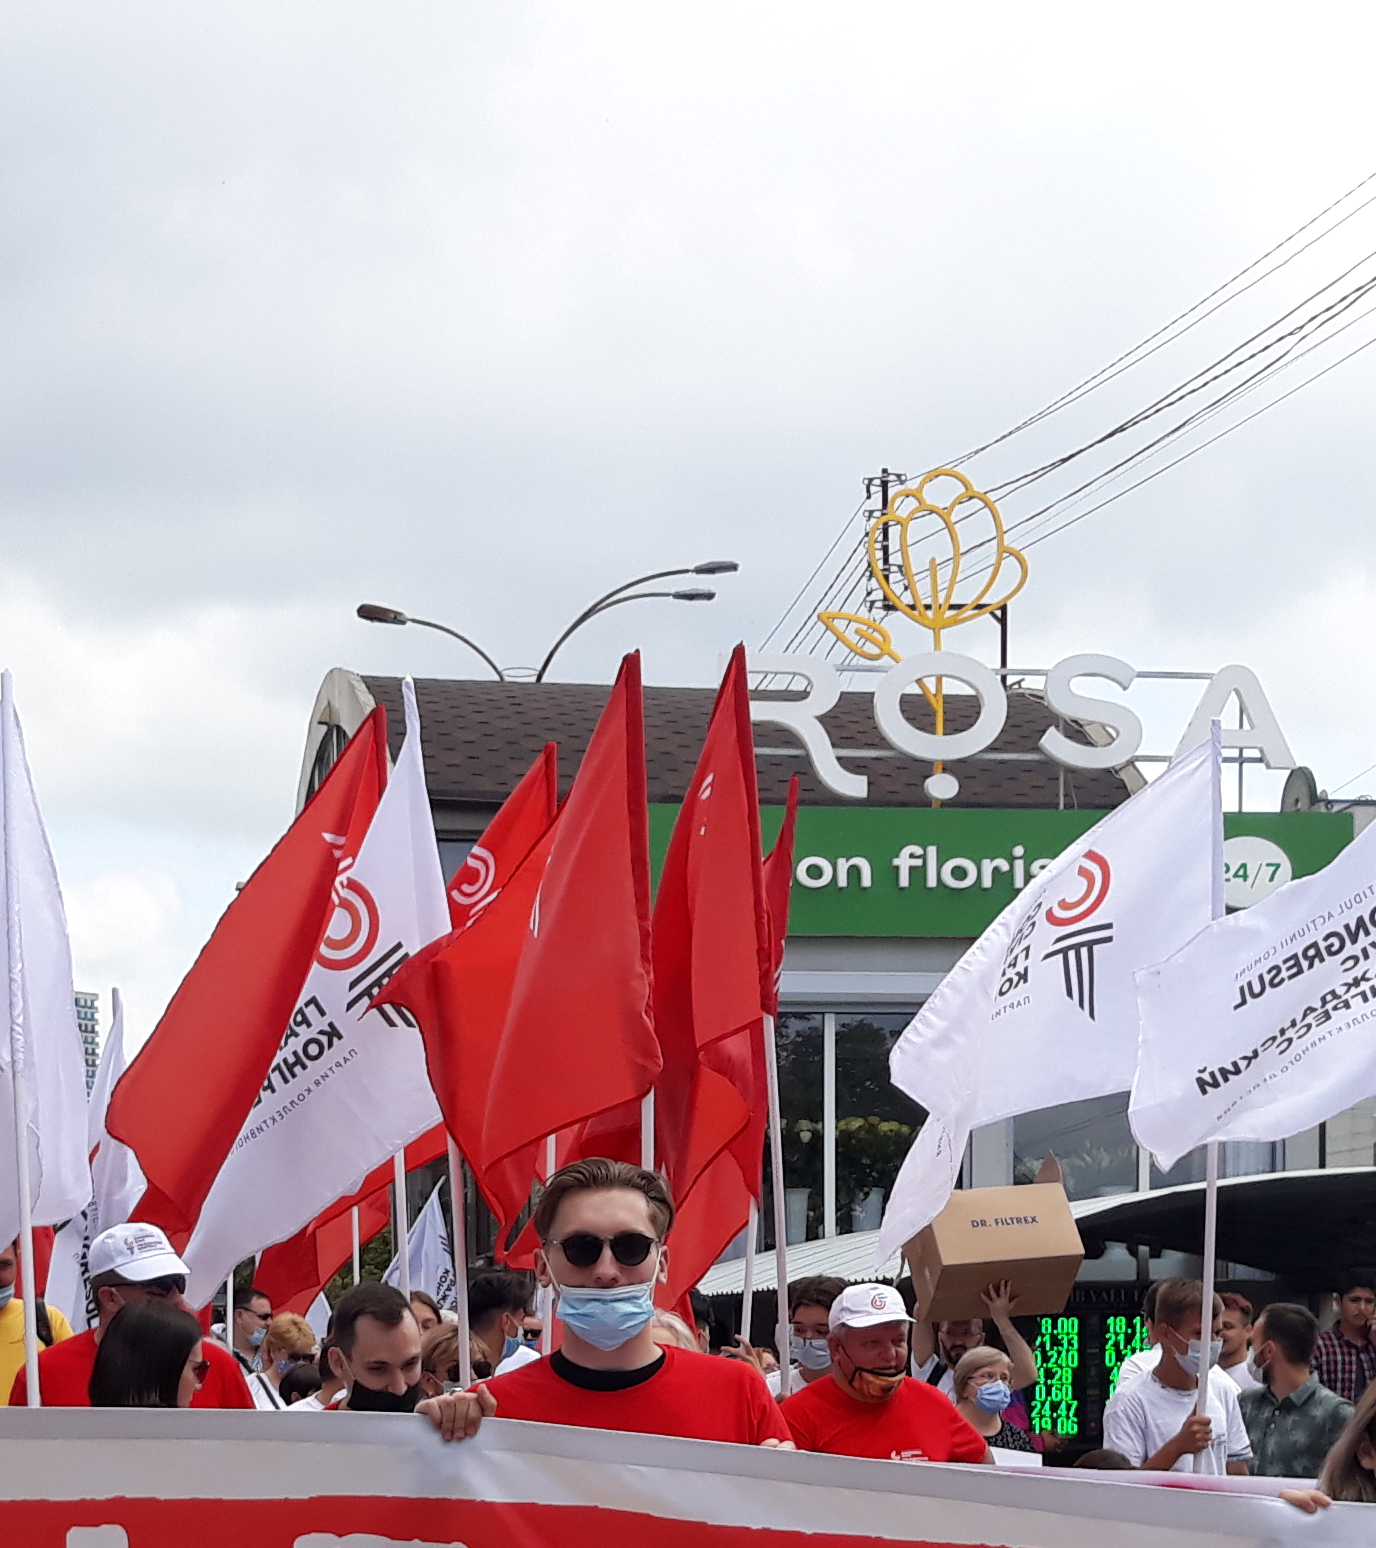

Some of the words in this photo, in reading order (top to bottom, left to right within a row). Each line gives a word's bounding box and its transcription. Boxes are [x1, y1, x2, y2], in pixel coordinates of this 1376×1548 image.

[718, 651, 1296, 800] ROSA
[790, 856, 872, 889] on
[970, 1218, 992, 1229] DR.
[994, 1215, 1039, 1227] FILTREX
[1035, 1384, 1072, 1401] 0.60
[1031, 1400, 1078, 1418] 24.47
